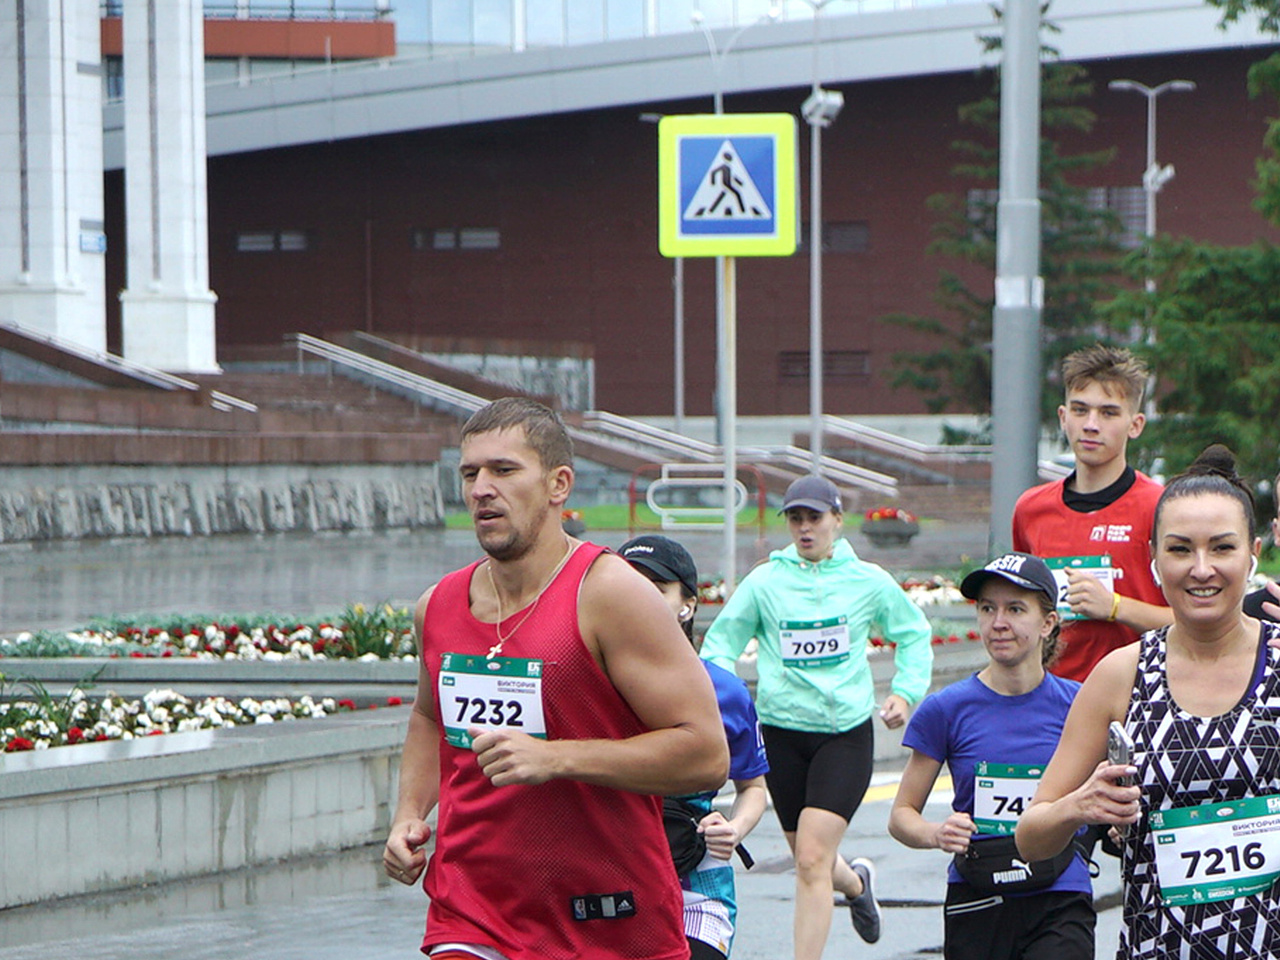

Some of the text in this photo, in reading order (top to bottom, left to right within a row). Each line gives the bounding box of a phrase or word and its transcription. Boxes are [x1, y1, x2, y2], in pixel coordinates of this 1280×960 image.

[791, 638, 839, 655] 7079
[455, 696, 524, 727] 7232
[993, 796, 1032, 816] 74
[1180, 842, 1266, 879] 7216
[992, 869, 1027, 884] PUMA
